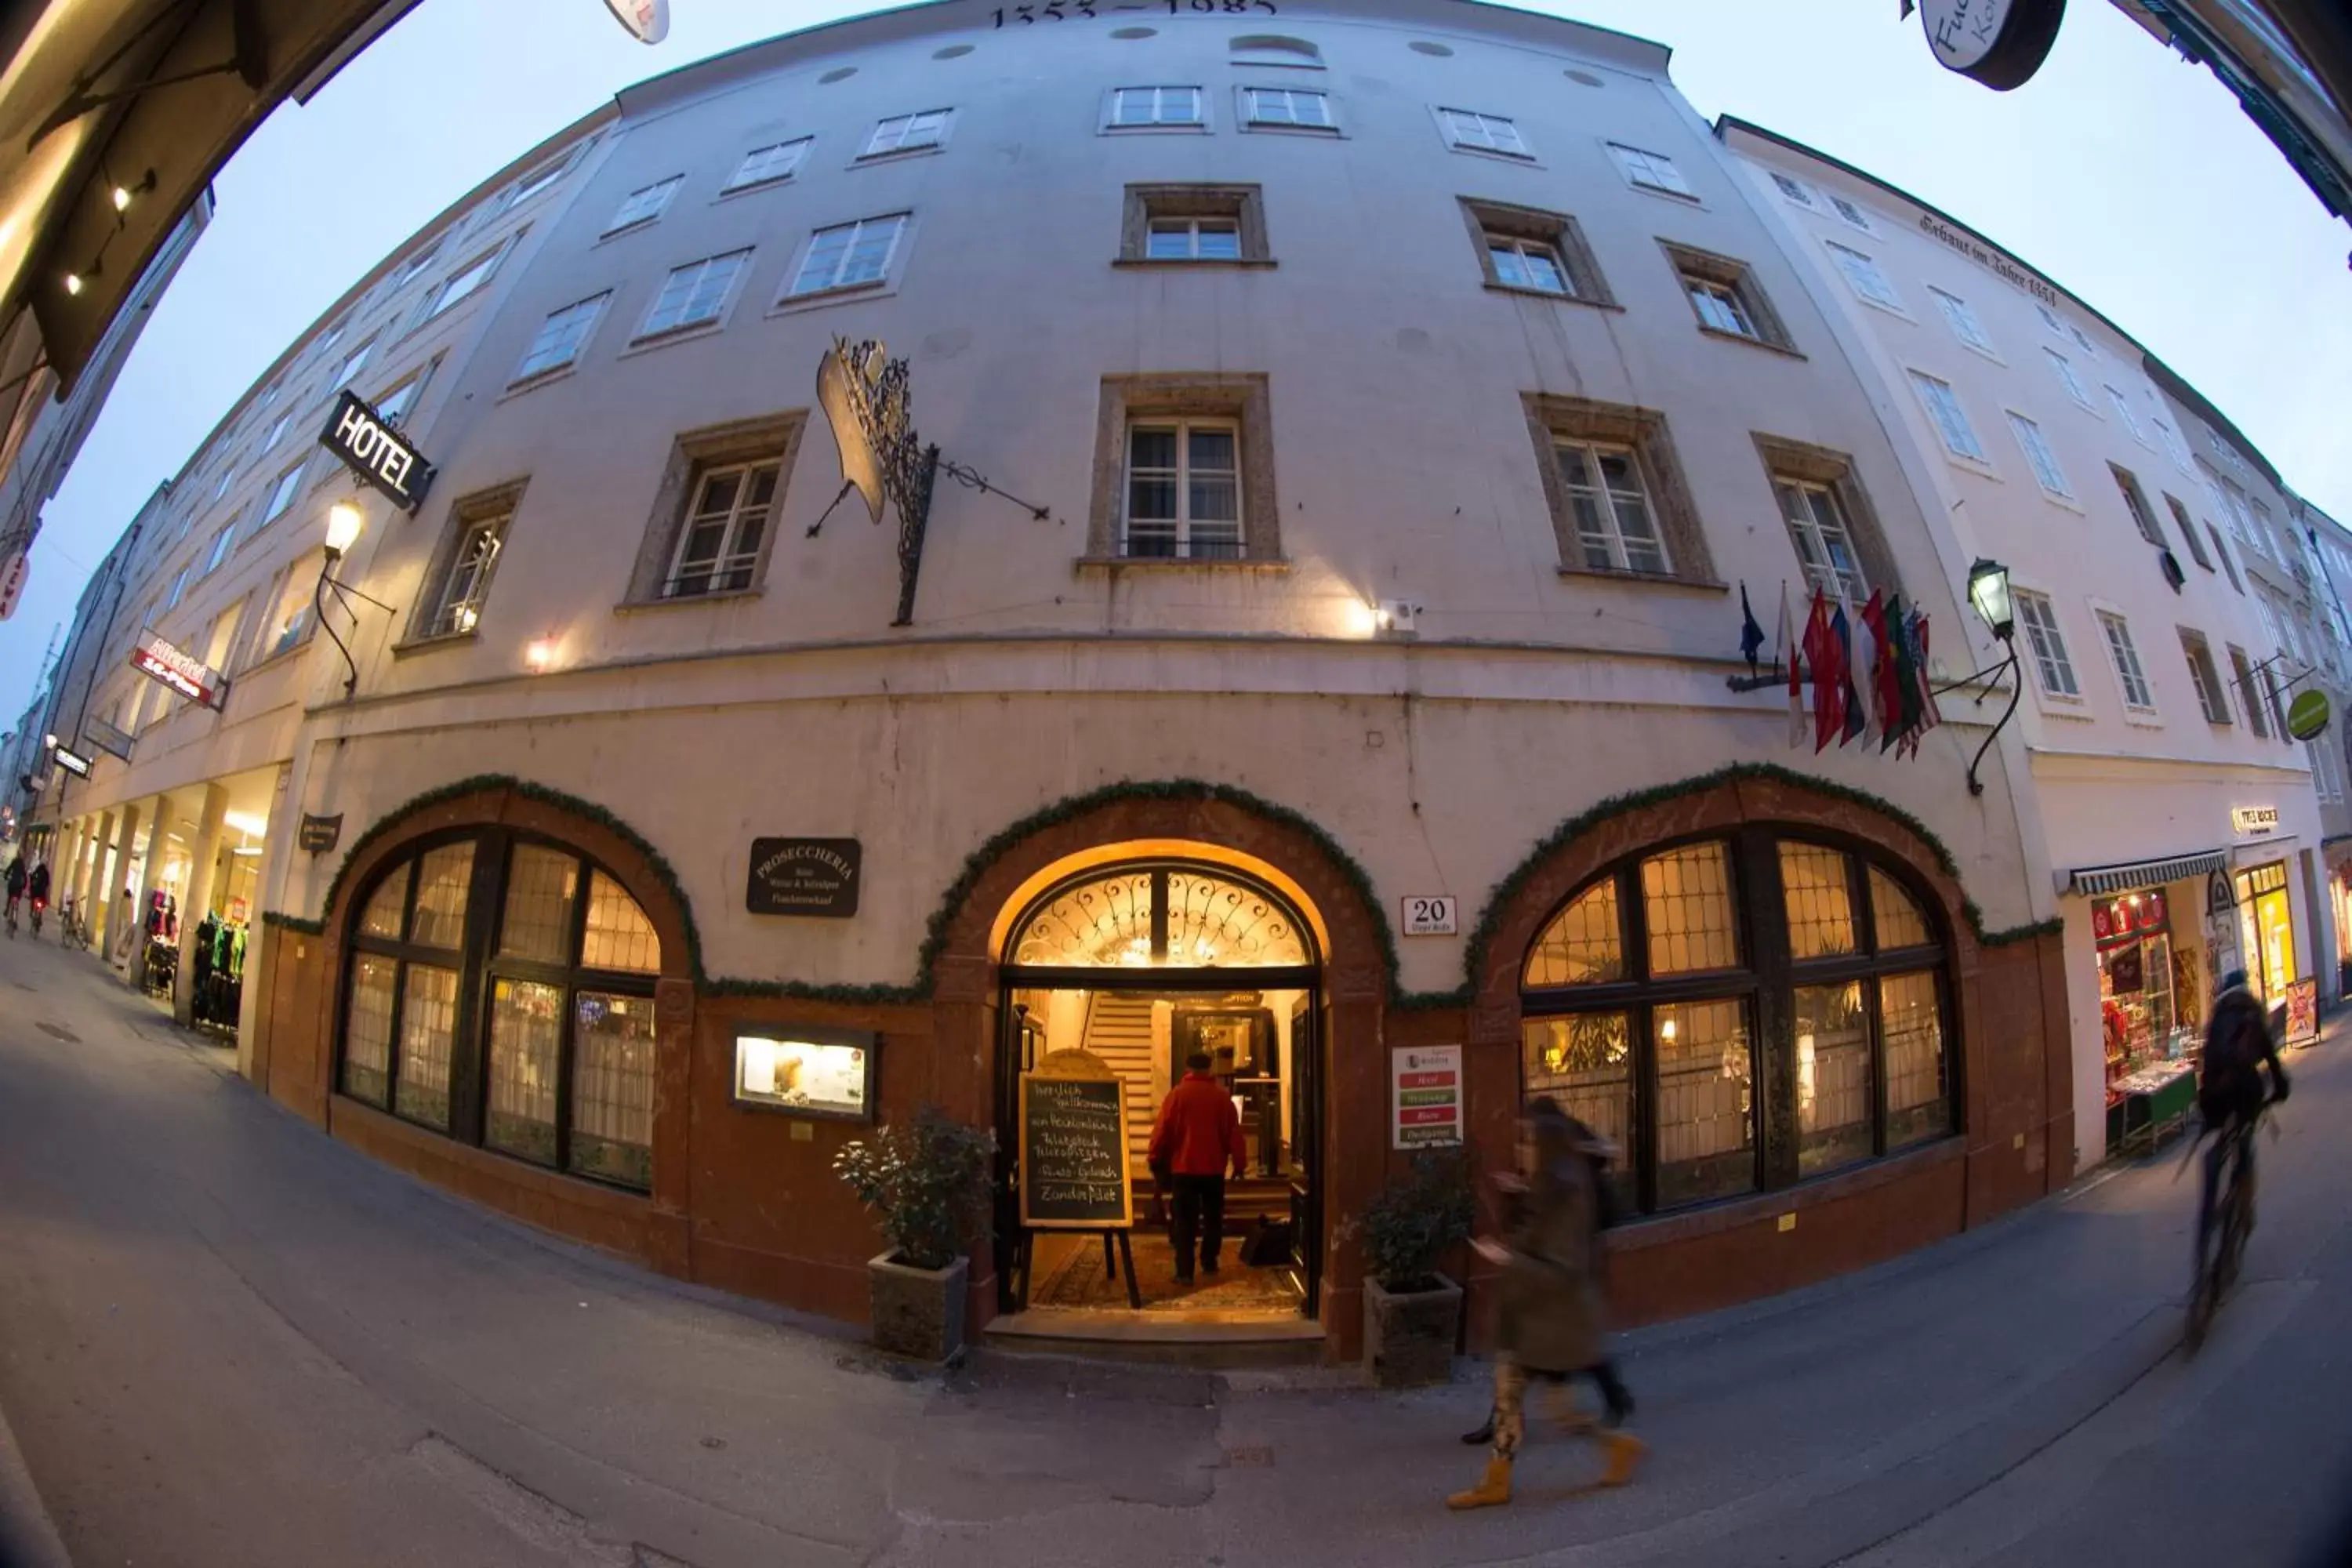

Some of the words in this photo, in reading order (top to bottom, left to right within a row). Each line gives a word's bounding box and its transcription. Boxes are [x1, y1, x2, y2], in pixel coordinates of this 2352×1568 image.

[335, 404, 414, 496] HOTEL
[756, 845, 853, 880] PROSECCHERIA
[1414, 899, 1445, 922] 20
